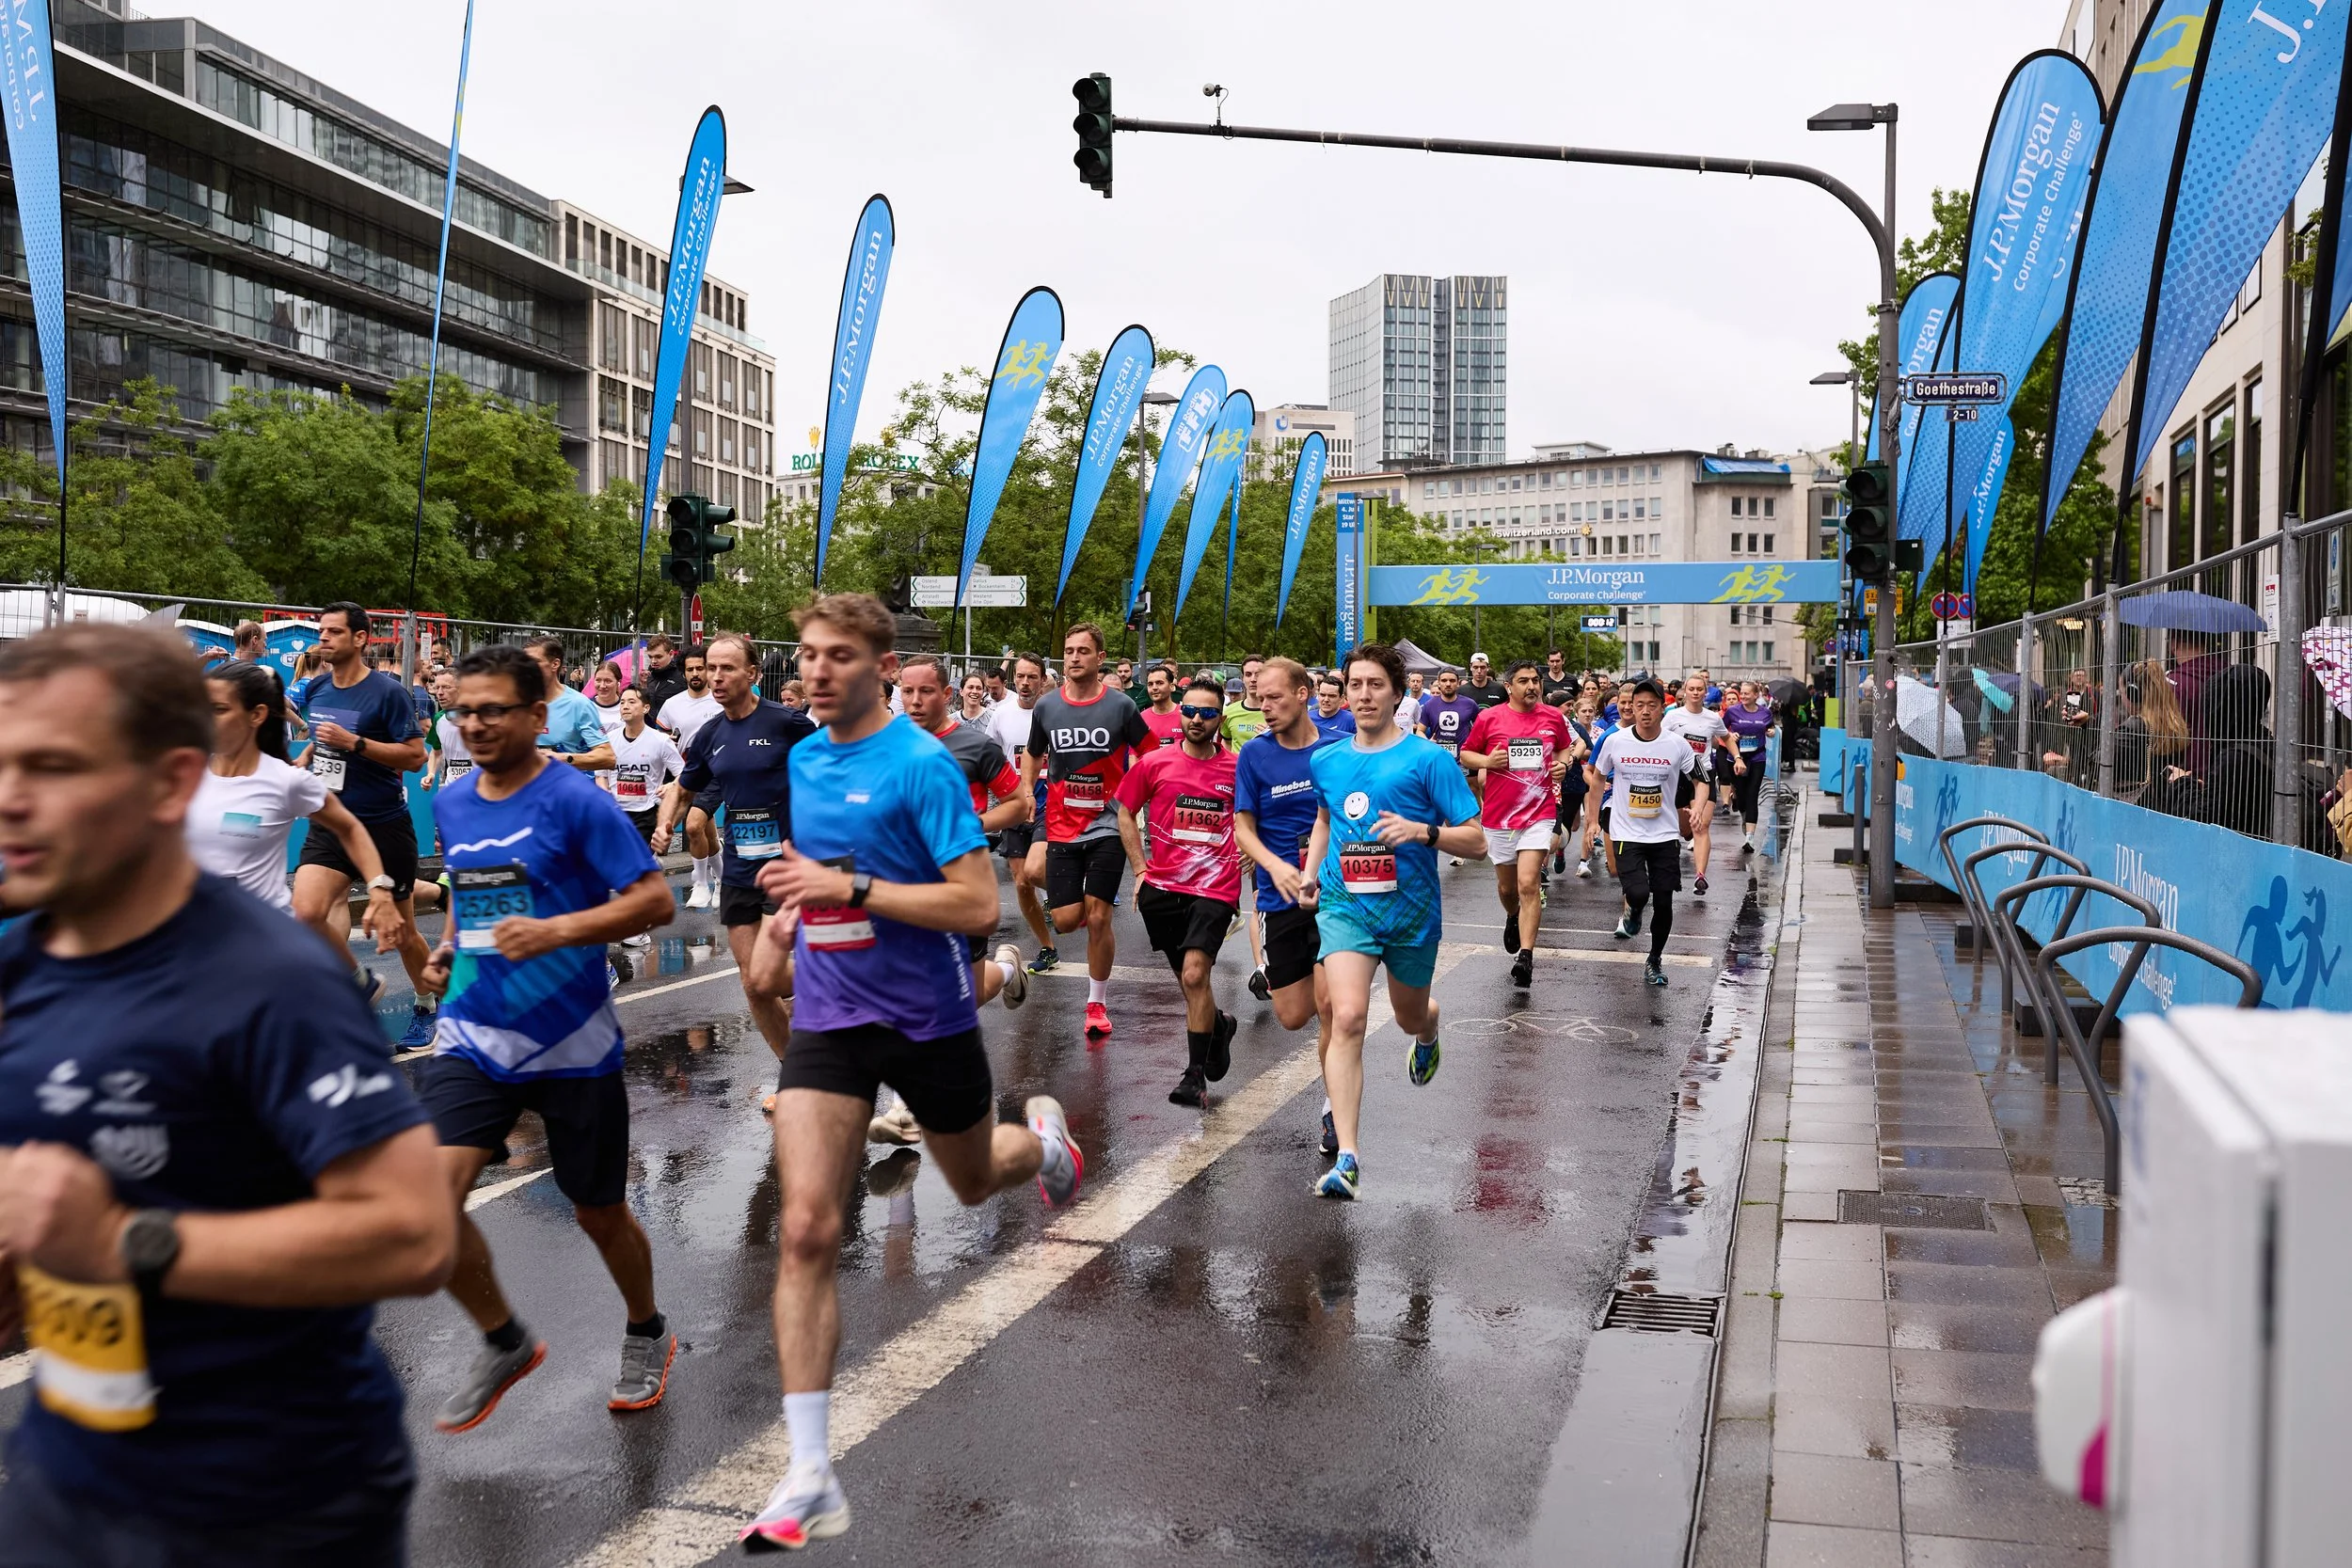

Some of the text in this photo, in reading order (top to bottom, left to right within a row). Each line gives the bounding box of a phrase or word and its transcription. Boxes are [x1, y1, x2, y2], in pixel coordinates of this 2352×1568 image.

[1982, 101, 2060, 282] J.P.Morgan
[669, 156, 709, 326] J.P.Morgan
[2013, 207, 2053, 292] Corporate
[678, 257, 699, 336] Corporate
[836, 230, 882, 405] J.P.Morgan
[1916, 381, 1996, 397] Goethestraße
[1087, 355, 1135, 460] J.P.Morgan
[1182, 391, 1200, 420] Radio
[1179, 390, 1213, 446] FFH
[1097, 417, 1121, 467] Corporate
[792, 453, 822, 470] ROL
[1290, 451, 1319, 540] J.P.Morgan
[1486, 527, 1577, 538] ySwitzerland.com
[1548, 568, 1645, 590] J.P.Morgan
[1548, 592, 1595, 601] Corporate
[1511, 748, 1542, 757] 59293
[1620, 756, 1671, 766] HONDA
[1069, 773, 1099, 783] J.P.Morgan
[617, 783, 646, 792] 10616
[1066, 784, 1102, 796] 10158
[1271, 780, 1311, 795] Minebea
[1183, 798, 1218, 809] J.P.Morgan
[1630, 794, 1661, 804] 71450
[736, 813, 770, 821] J.P.Morgan
[1178, 810, 1220, 827] 11362
[734, 824, 776, 839] 22197
[1346, 844, 1386, 854] J.P.Morgan
[1343, 859, 1393, 875] 10375
